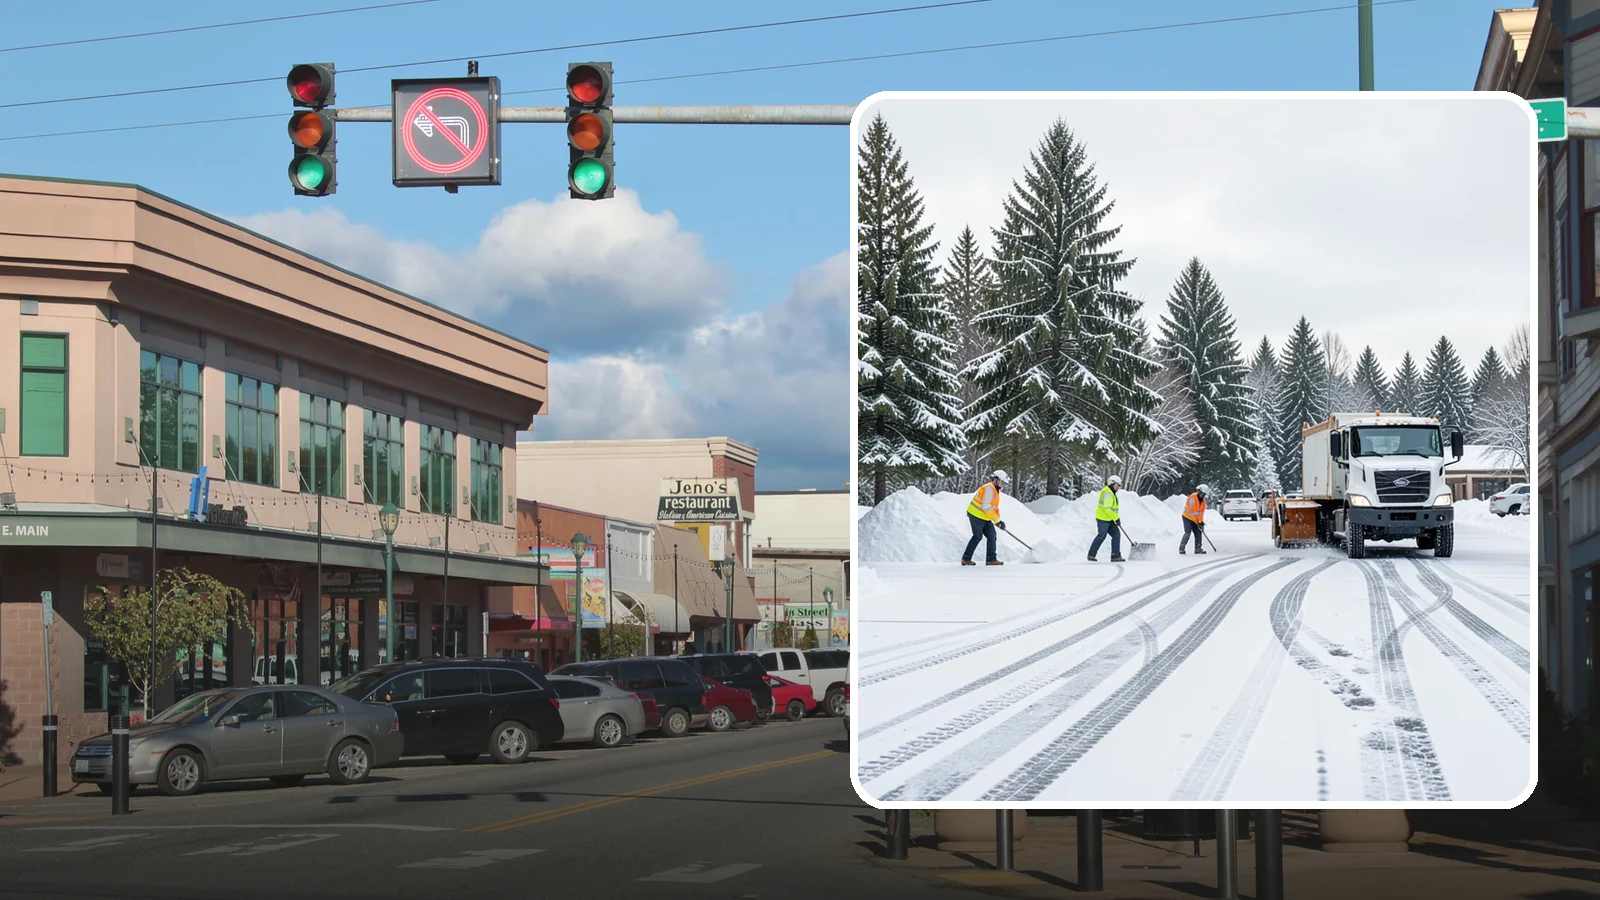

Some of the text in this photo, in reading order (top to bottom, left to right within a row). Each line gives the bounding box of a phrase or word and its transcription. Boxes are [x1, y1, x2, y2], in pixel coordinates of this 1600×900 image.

[670, 480, 727, 494] Jeno's
[665, 496, 731, 509] restaurant
[658, 510, 681, 519] Italian
[686, 510, 714, 519] American
[714, 509, 738, 519] Cuisine
[2, 525, 49, 536] E. MAIN
[797, 607, 828, 617] Street
[790, 619, 824, 627] lass
